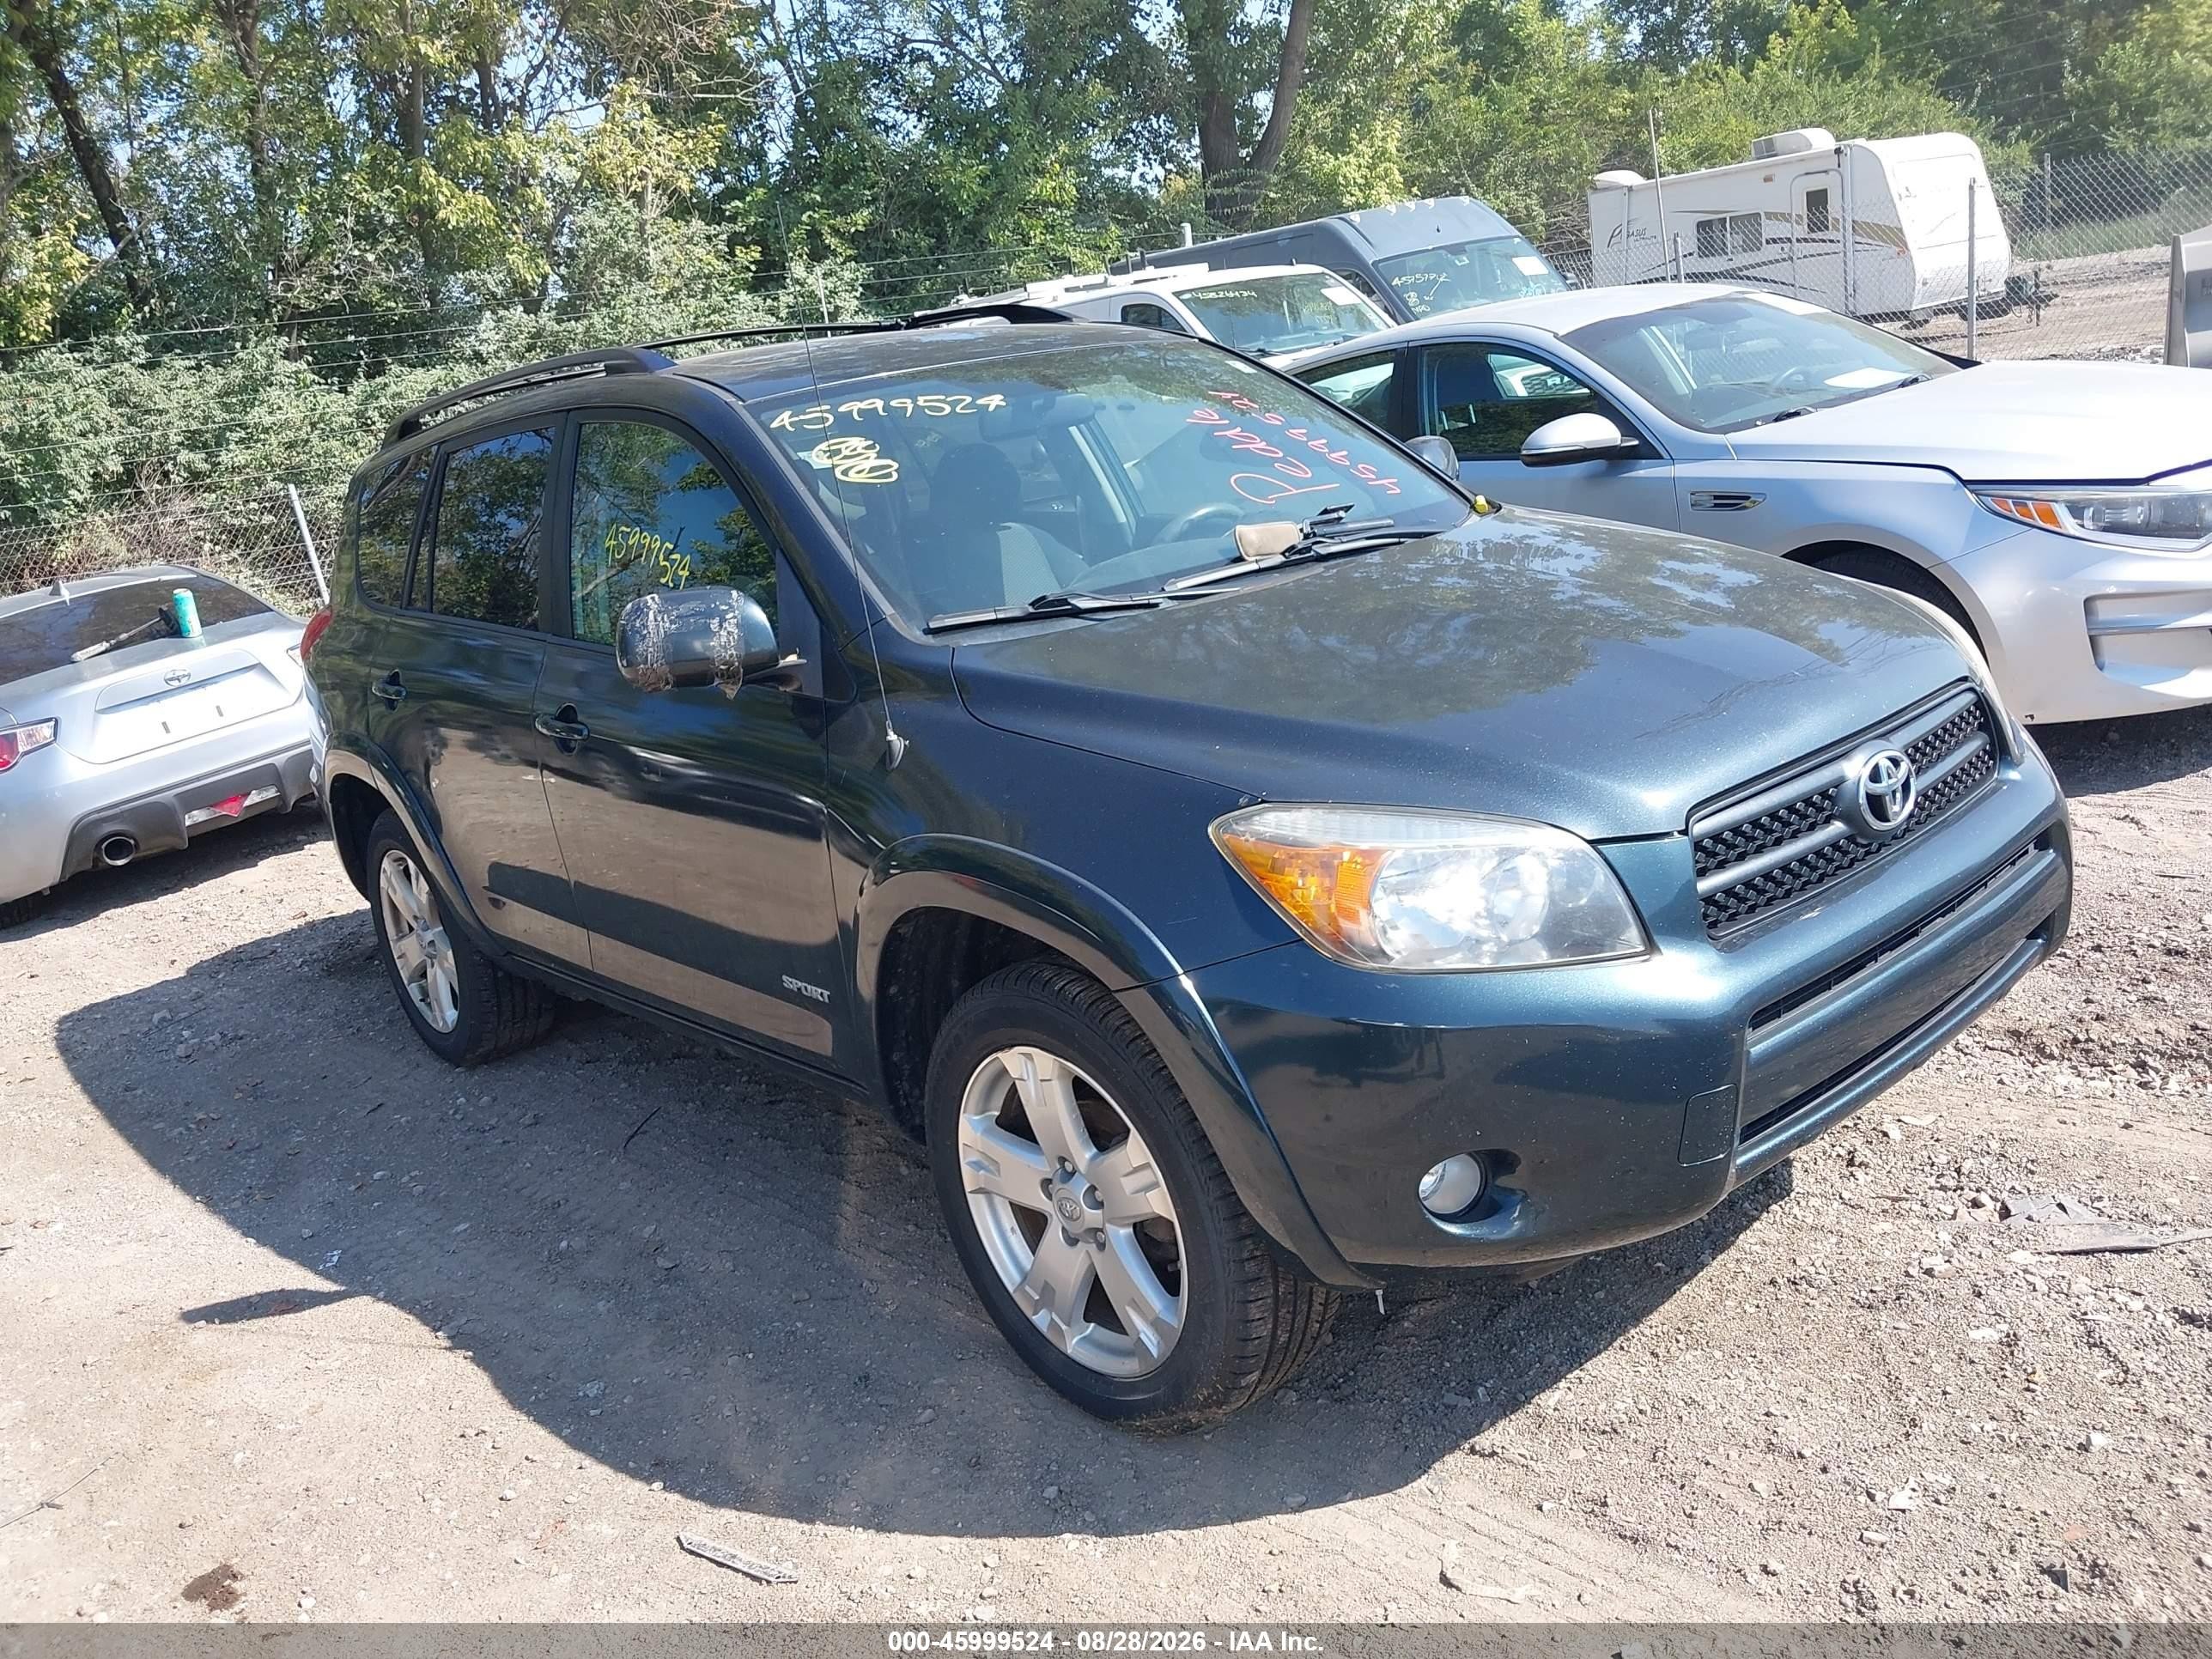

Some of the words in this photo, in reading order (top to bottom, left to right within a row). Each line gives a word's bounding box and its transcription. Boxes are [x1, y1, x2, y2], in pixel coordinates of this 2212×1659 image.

[769, 394, 1007, 431] 45999524
[1208, 391, 1401, 495] 45999524
[605, 522, 691, 590] 45999524
[781, 975, 831, 1003] SPORT
